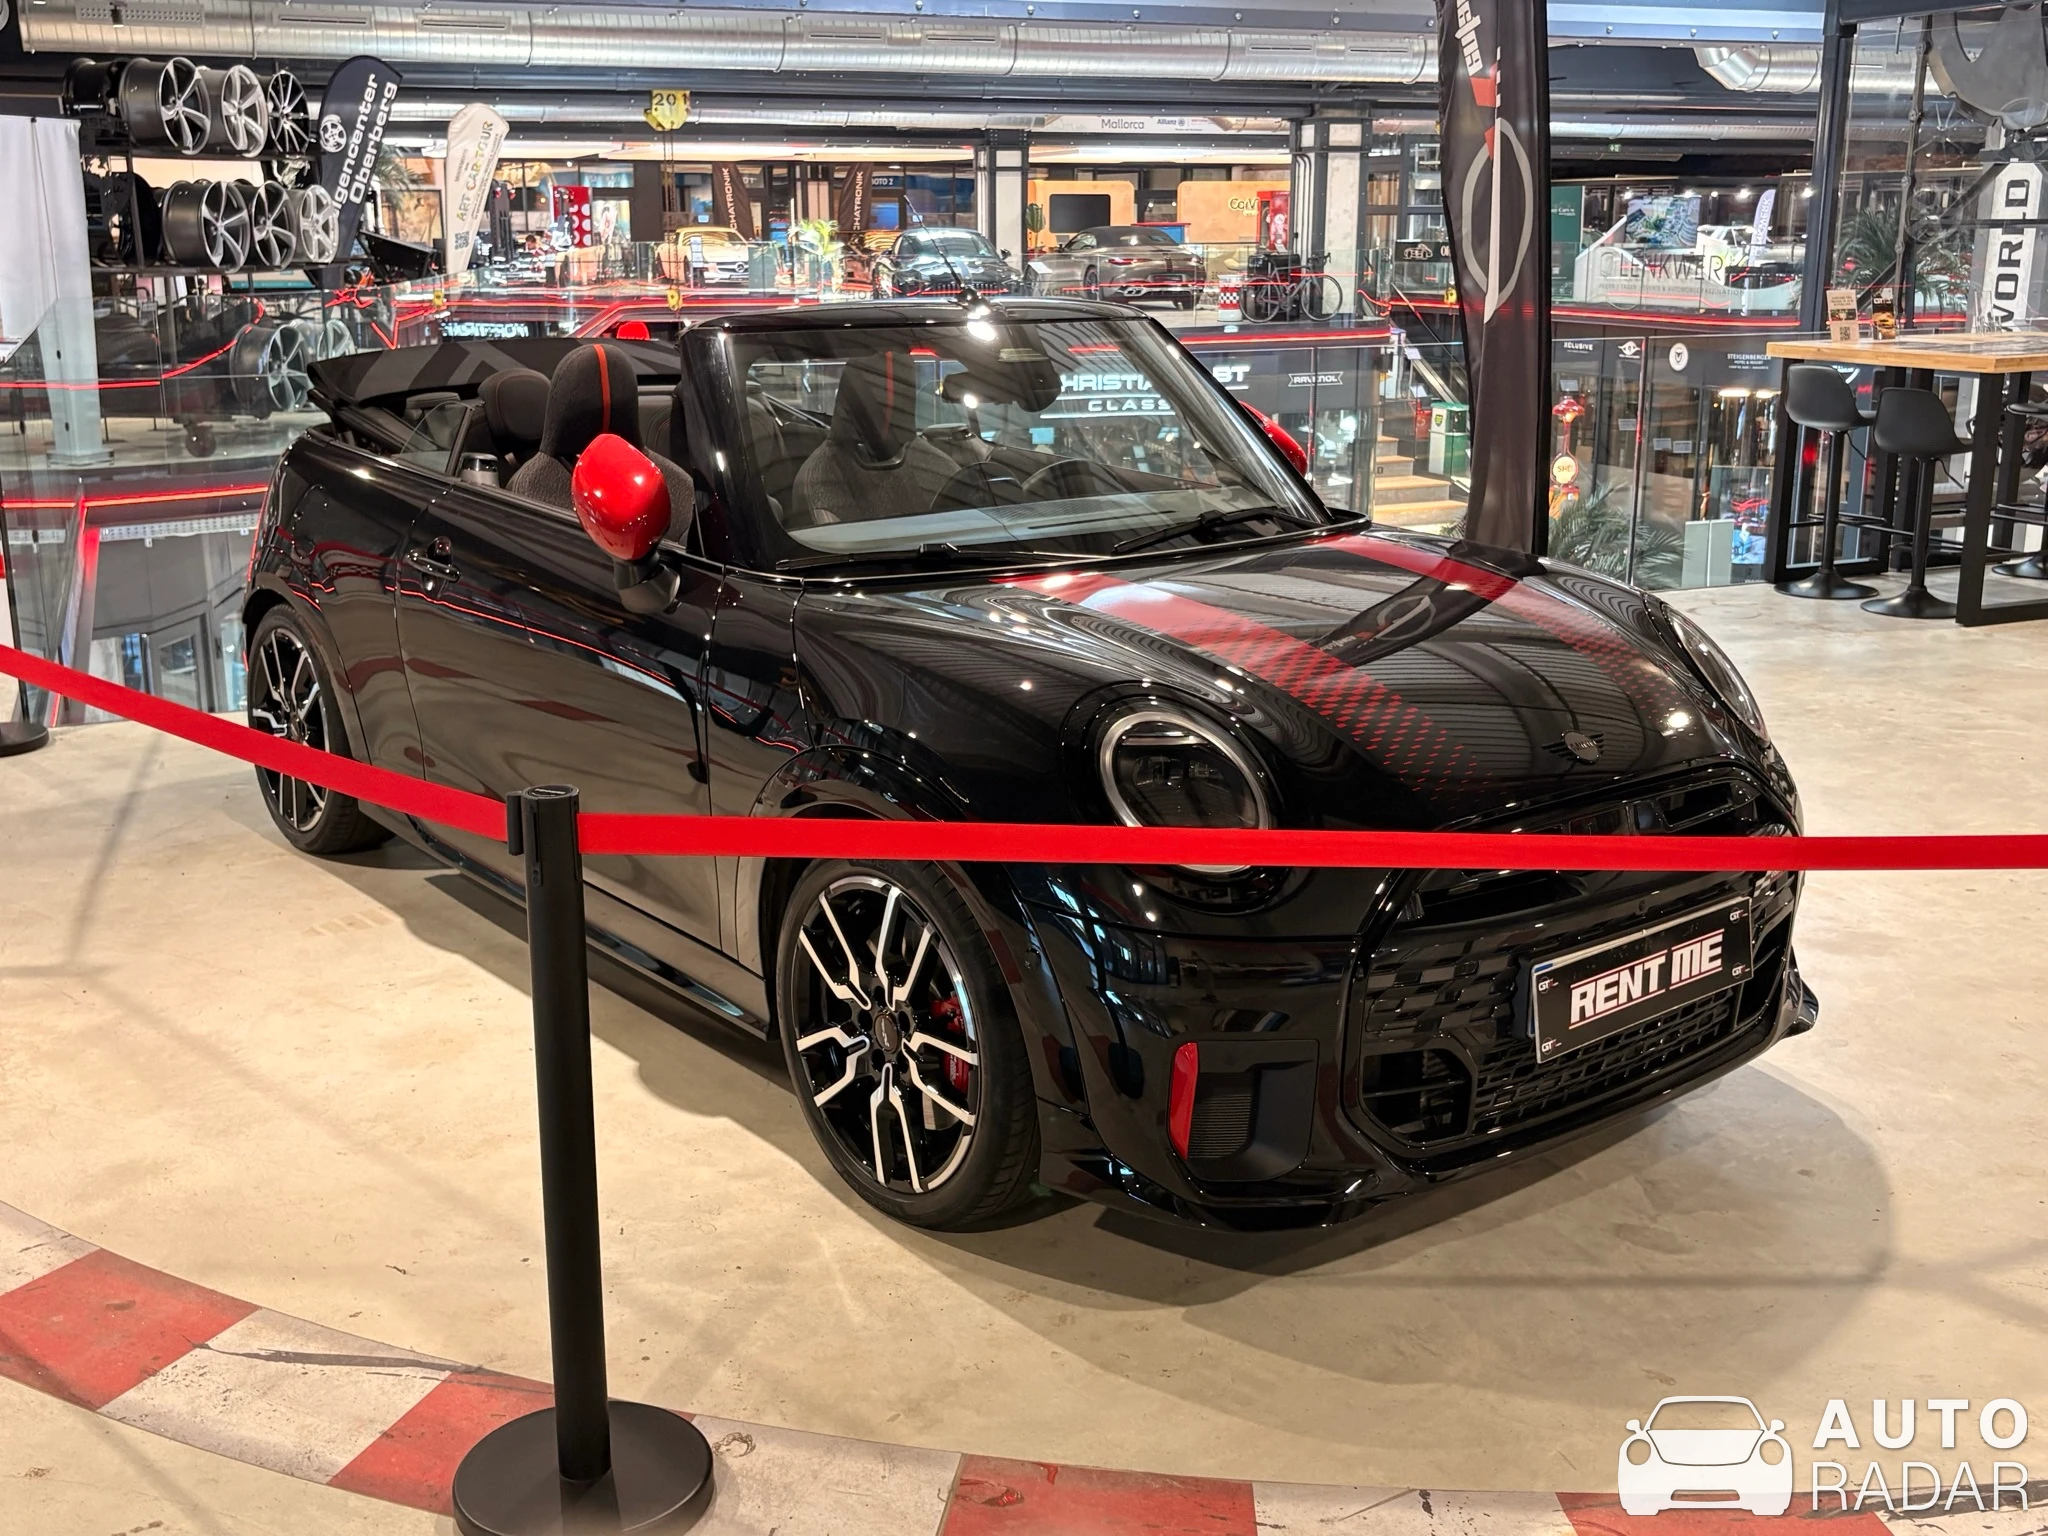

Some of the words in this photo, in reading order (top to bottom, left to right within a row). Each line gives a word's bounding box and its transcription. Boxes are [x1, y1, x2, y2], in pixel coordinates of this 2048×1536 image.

[350, 81, 398, 204] Oberberg
[1101, 118, 1145, 129] Mallorca
[456, 192, 471, 222] ART
[466, 162, 481, 191] CAR
[475, 121, 494, 161] TOUR
[721, 167, 738, 231] CHATRONIK
[851, 170, 864, 231] CHATRONIK
[888, 177, 894, 186] 2
[1993, 178, 2031, 333] WORLD
[1563, 341, 1594, 351] XCLUSIVE
[1727, 353, 1771, 361] STEIGENBERGER
[1293, 374, 1338, 384] RAVENOL
[1570, 952, 1667, 1026] RENT
[1671, 932, 1724, 987] ME
